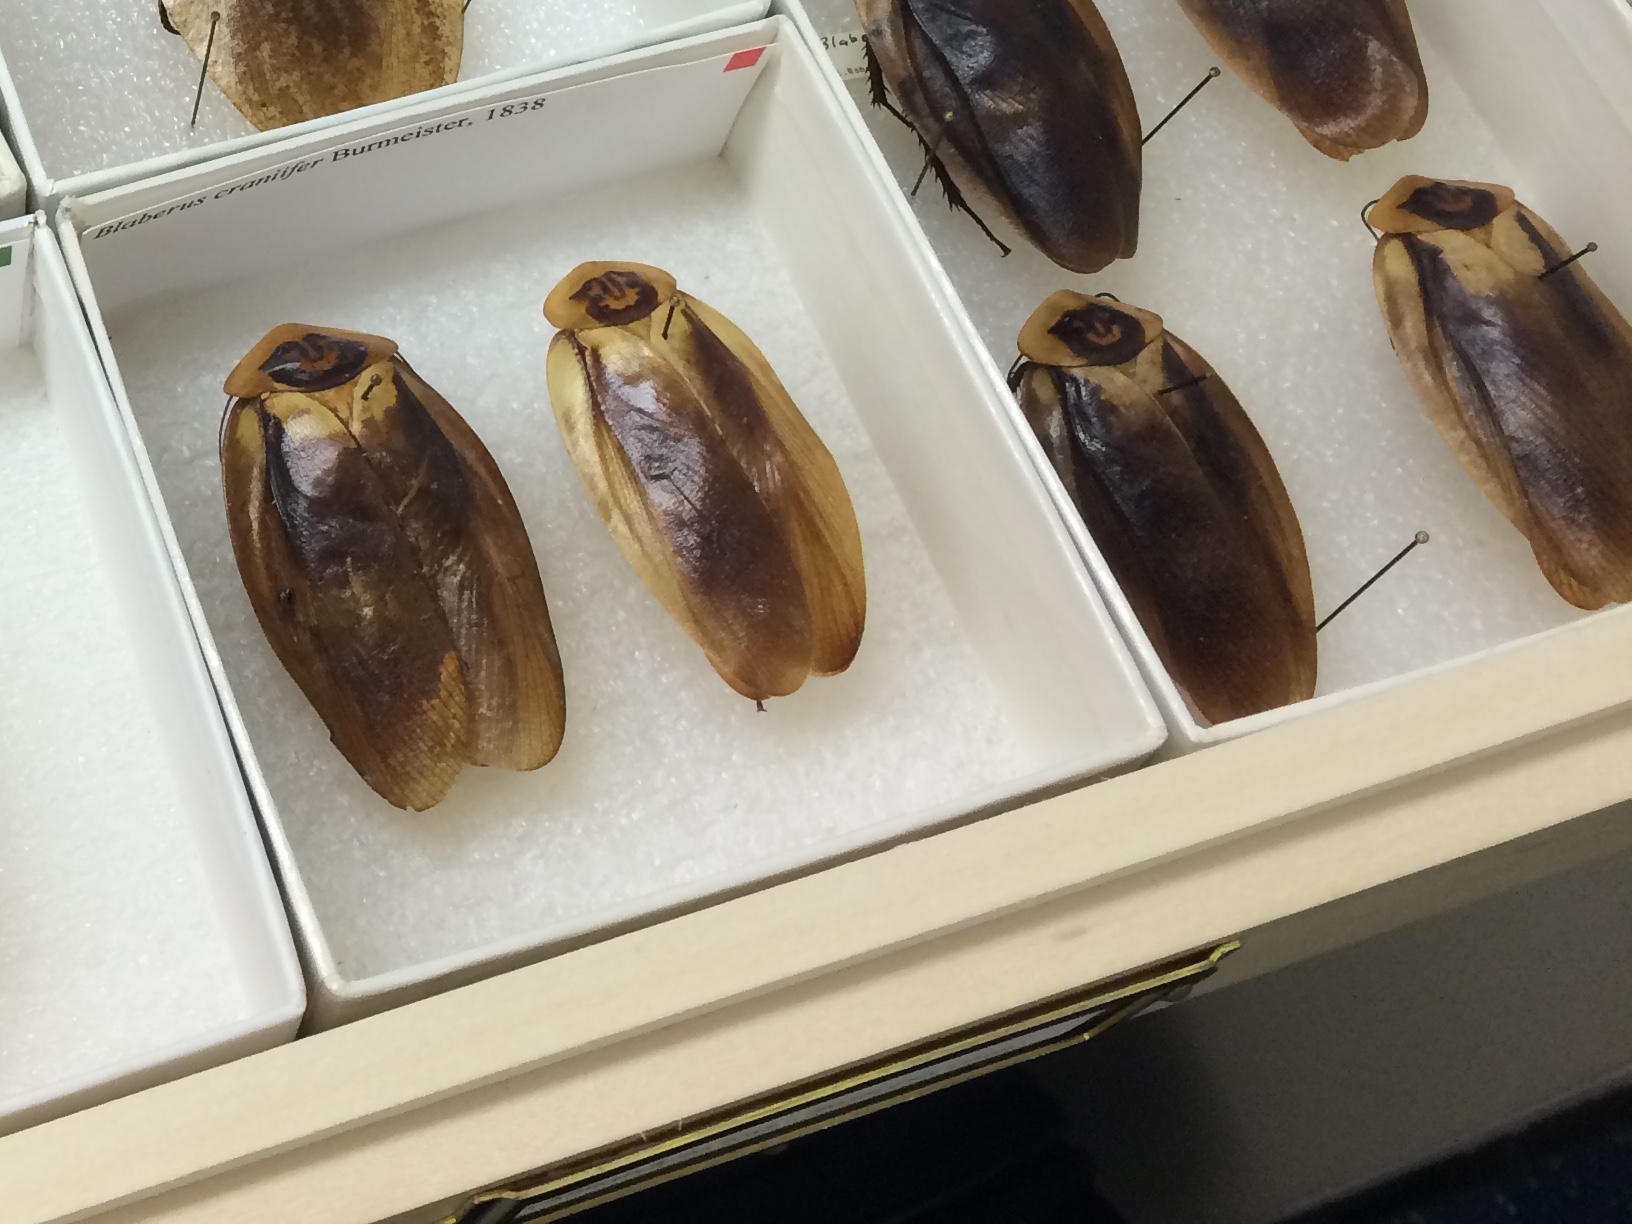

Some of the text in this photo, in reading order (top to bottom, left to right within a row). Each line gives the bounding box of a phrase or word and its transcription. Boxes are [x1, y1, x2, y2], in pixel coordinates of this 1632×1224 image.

[93, 98, 546, 240] Blaberus craniifer Burmeister, 1838
